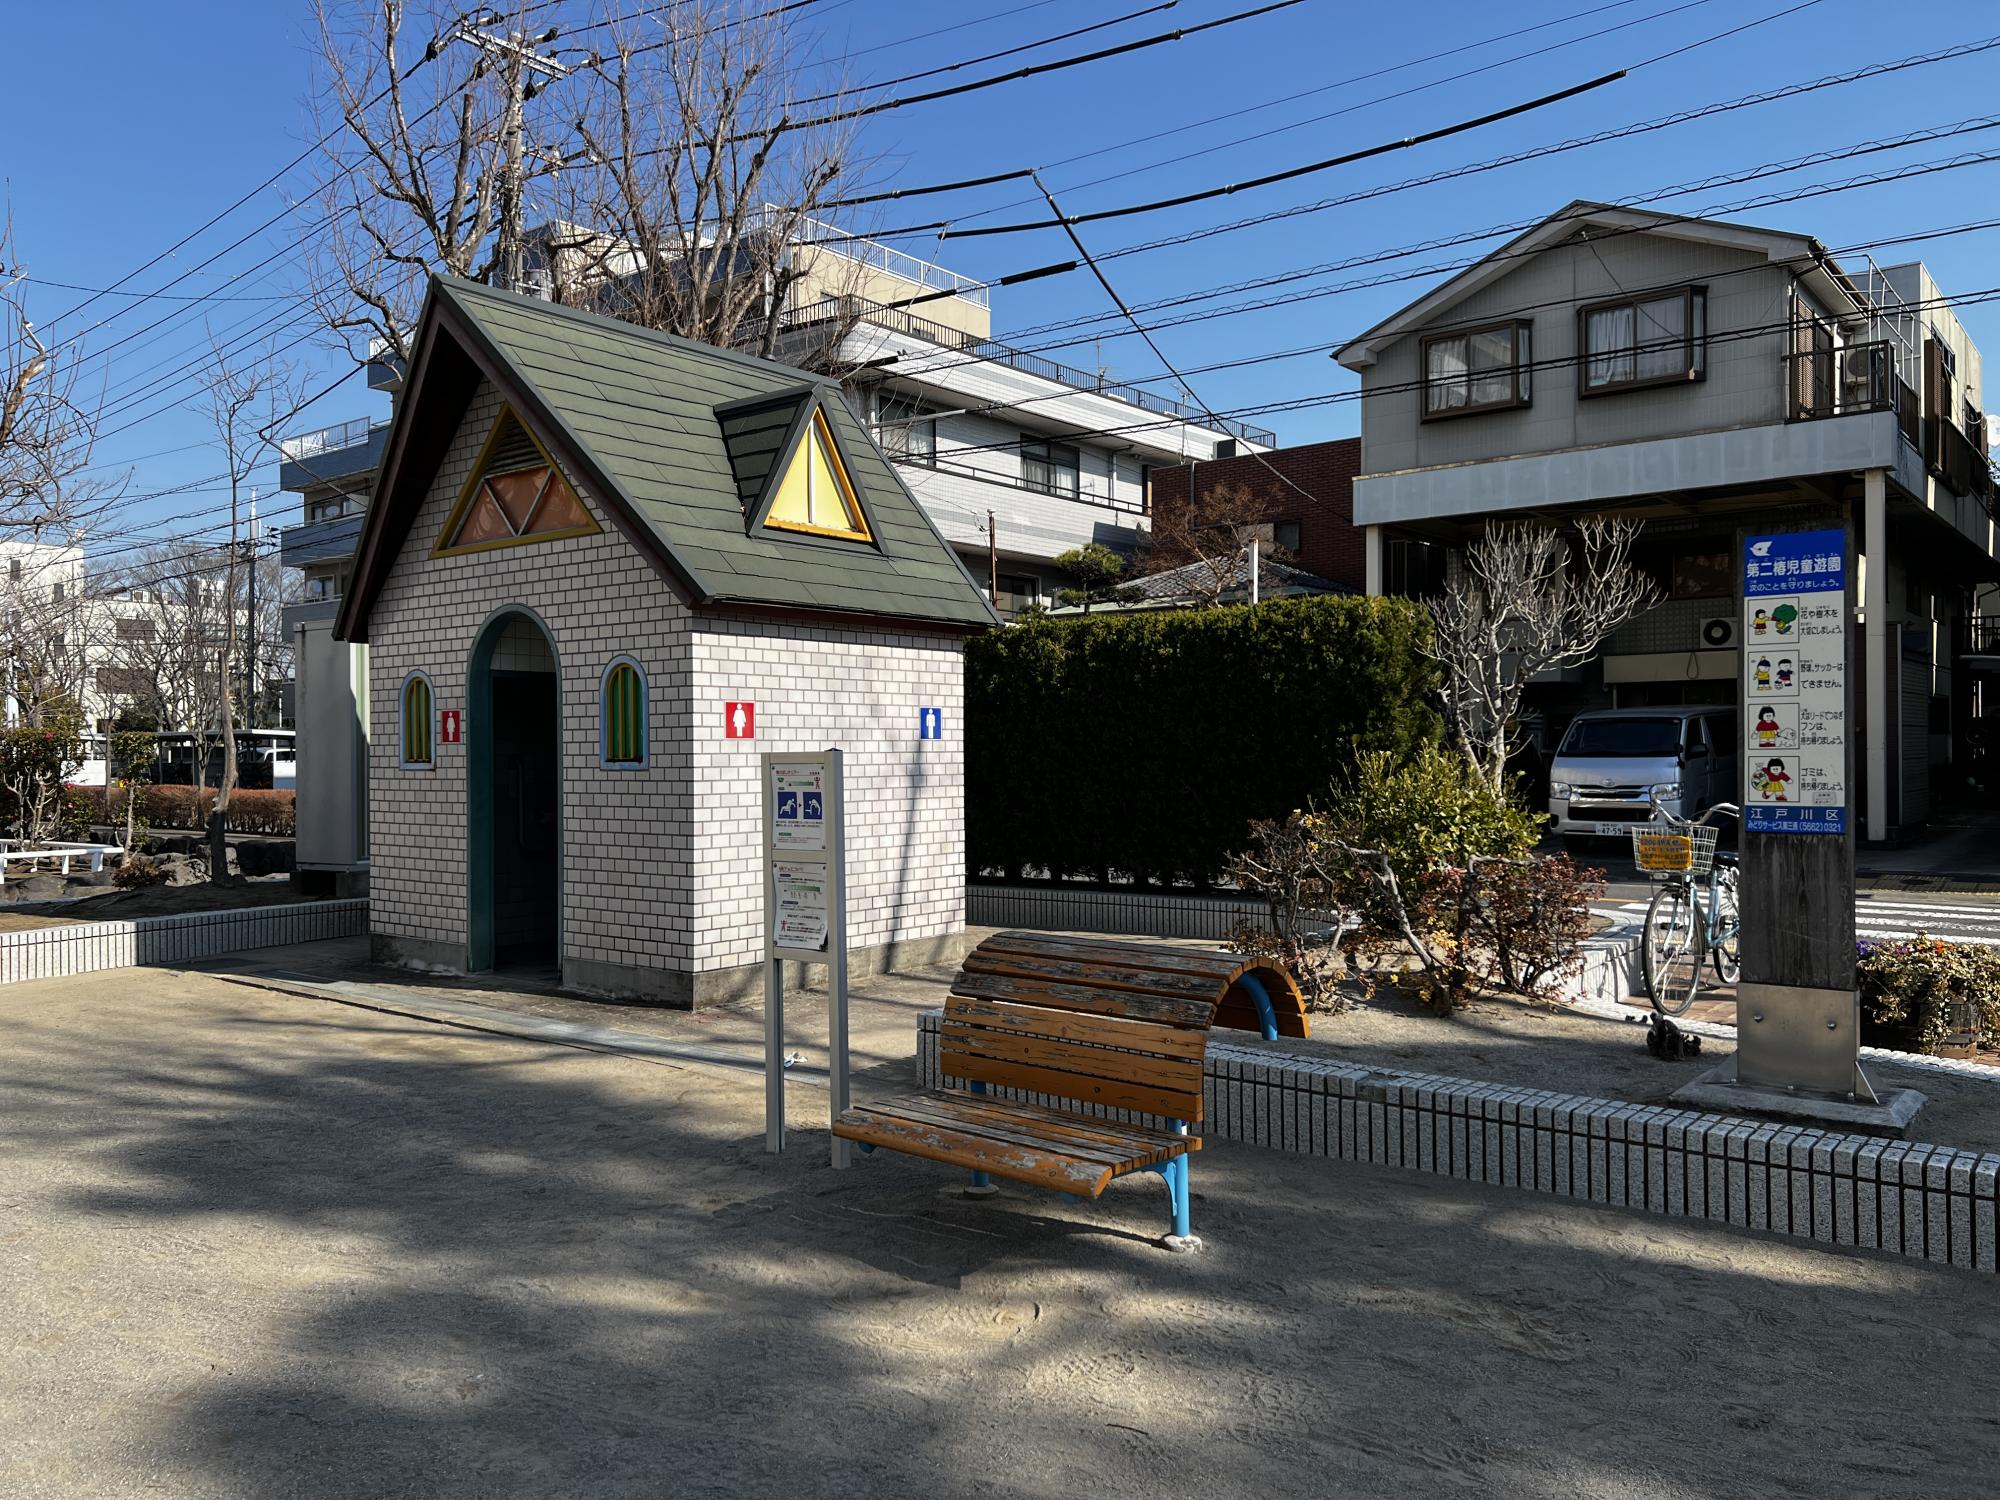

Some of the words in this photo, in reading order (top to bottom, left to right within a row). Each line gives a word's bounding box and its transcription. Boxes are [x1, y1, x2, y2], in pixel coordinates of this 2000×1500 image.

[1747, 557, 1840, 577] 第二椿児童遊園
[1749, 579, 1840, 592] 次のことを守りましょう。
[1801, 680, 1842, 688] できません。
[1801, 768, 1827, 776] ゴミは、
[1751, 808, 1839, 820] 江戸川区
